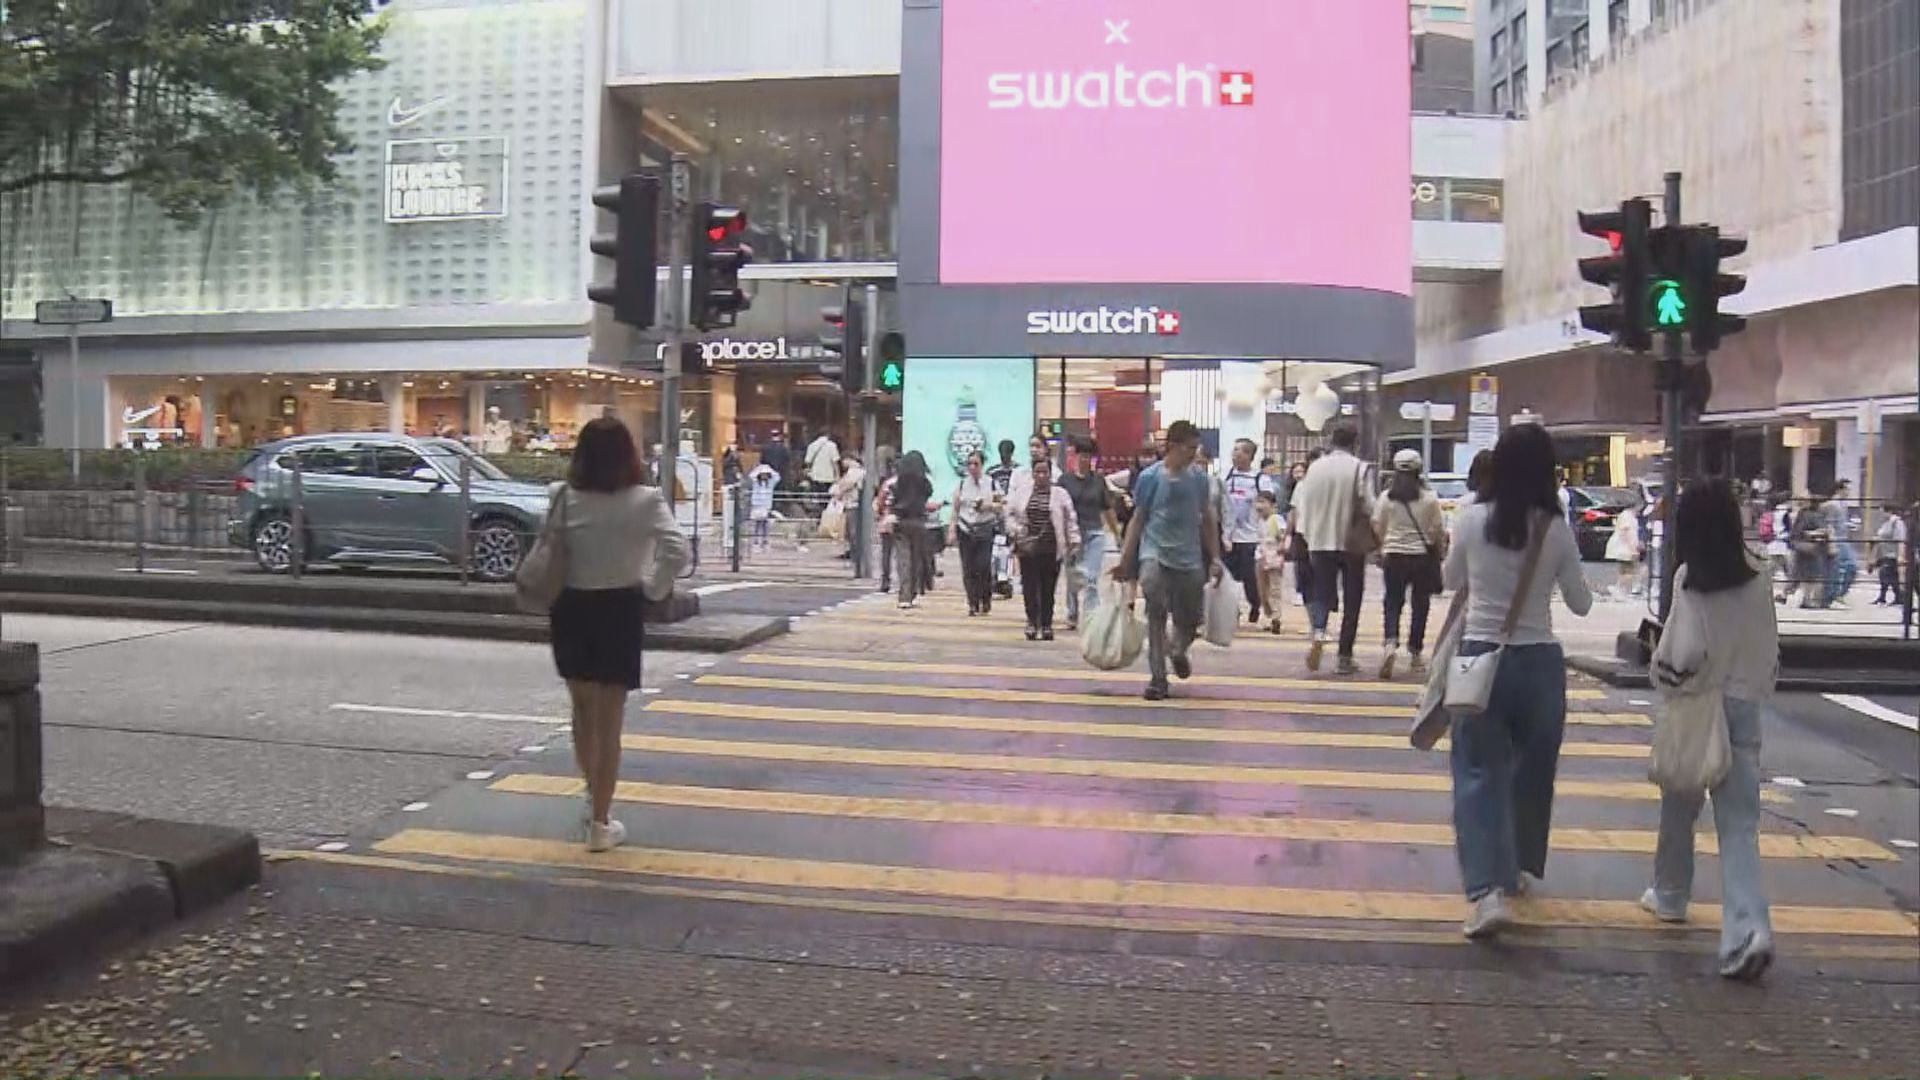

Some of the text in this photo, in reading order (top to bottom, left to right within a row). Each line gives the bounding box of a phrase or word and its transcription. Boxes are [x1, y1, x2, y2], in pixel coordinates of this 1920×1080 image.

[988, 63, 1212, 108] swatch
[391, 186, 484, 217] LOUNGE
[1027, 306, 1158, 333] swatch
